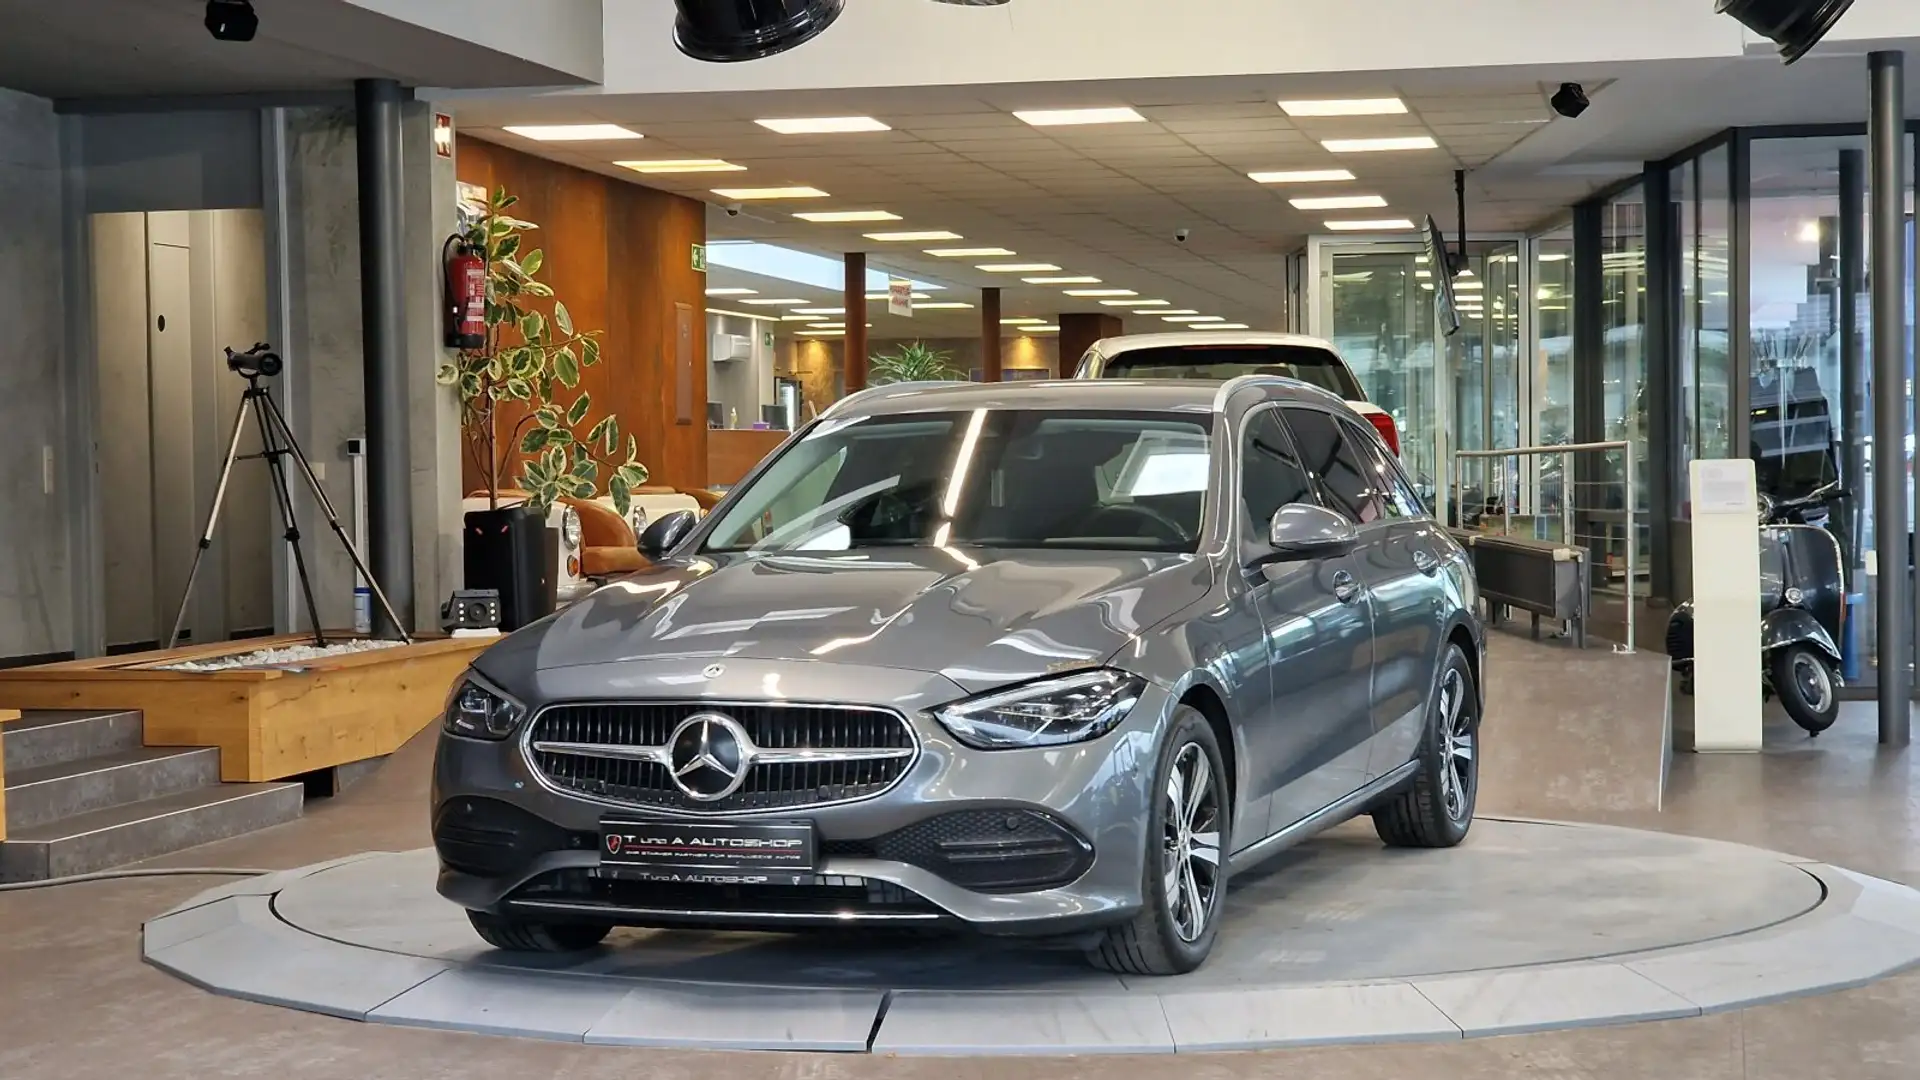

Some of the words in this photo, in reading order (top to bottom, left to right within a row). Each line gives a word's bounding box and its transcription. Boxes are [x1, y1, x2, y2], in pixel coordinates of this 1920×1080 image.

[672, 837, 684, 845] A
[689, 837, 803, 848] AUTOSHOP
[685, 874, 768, 884] AUTOSHOP
